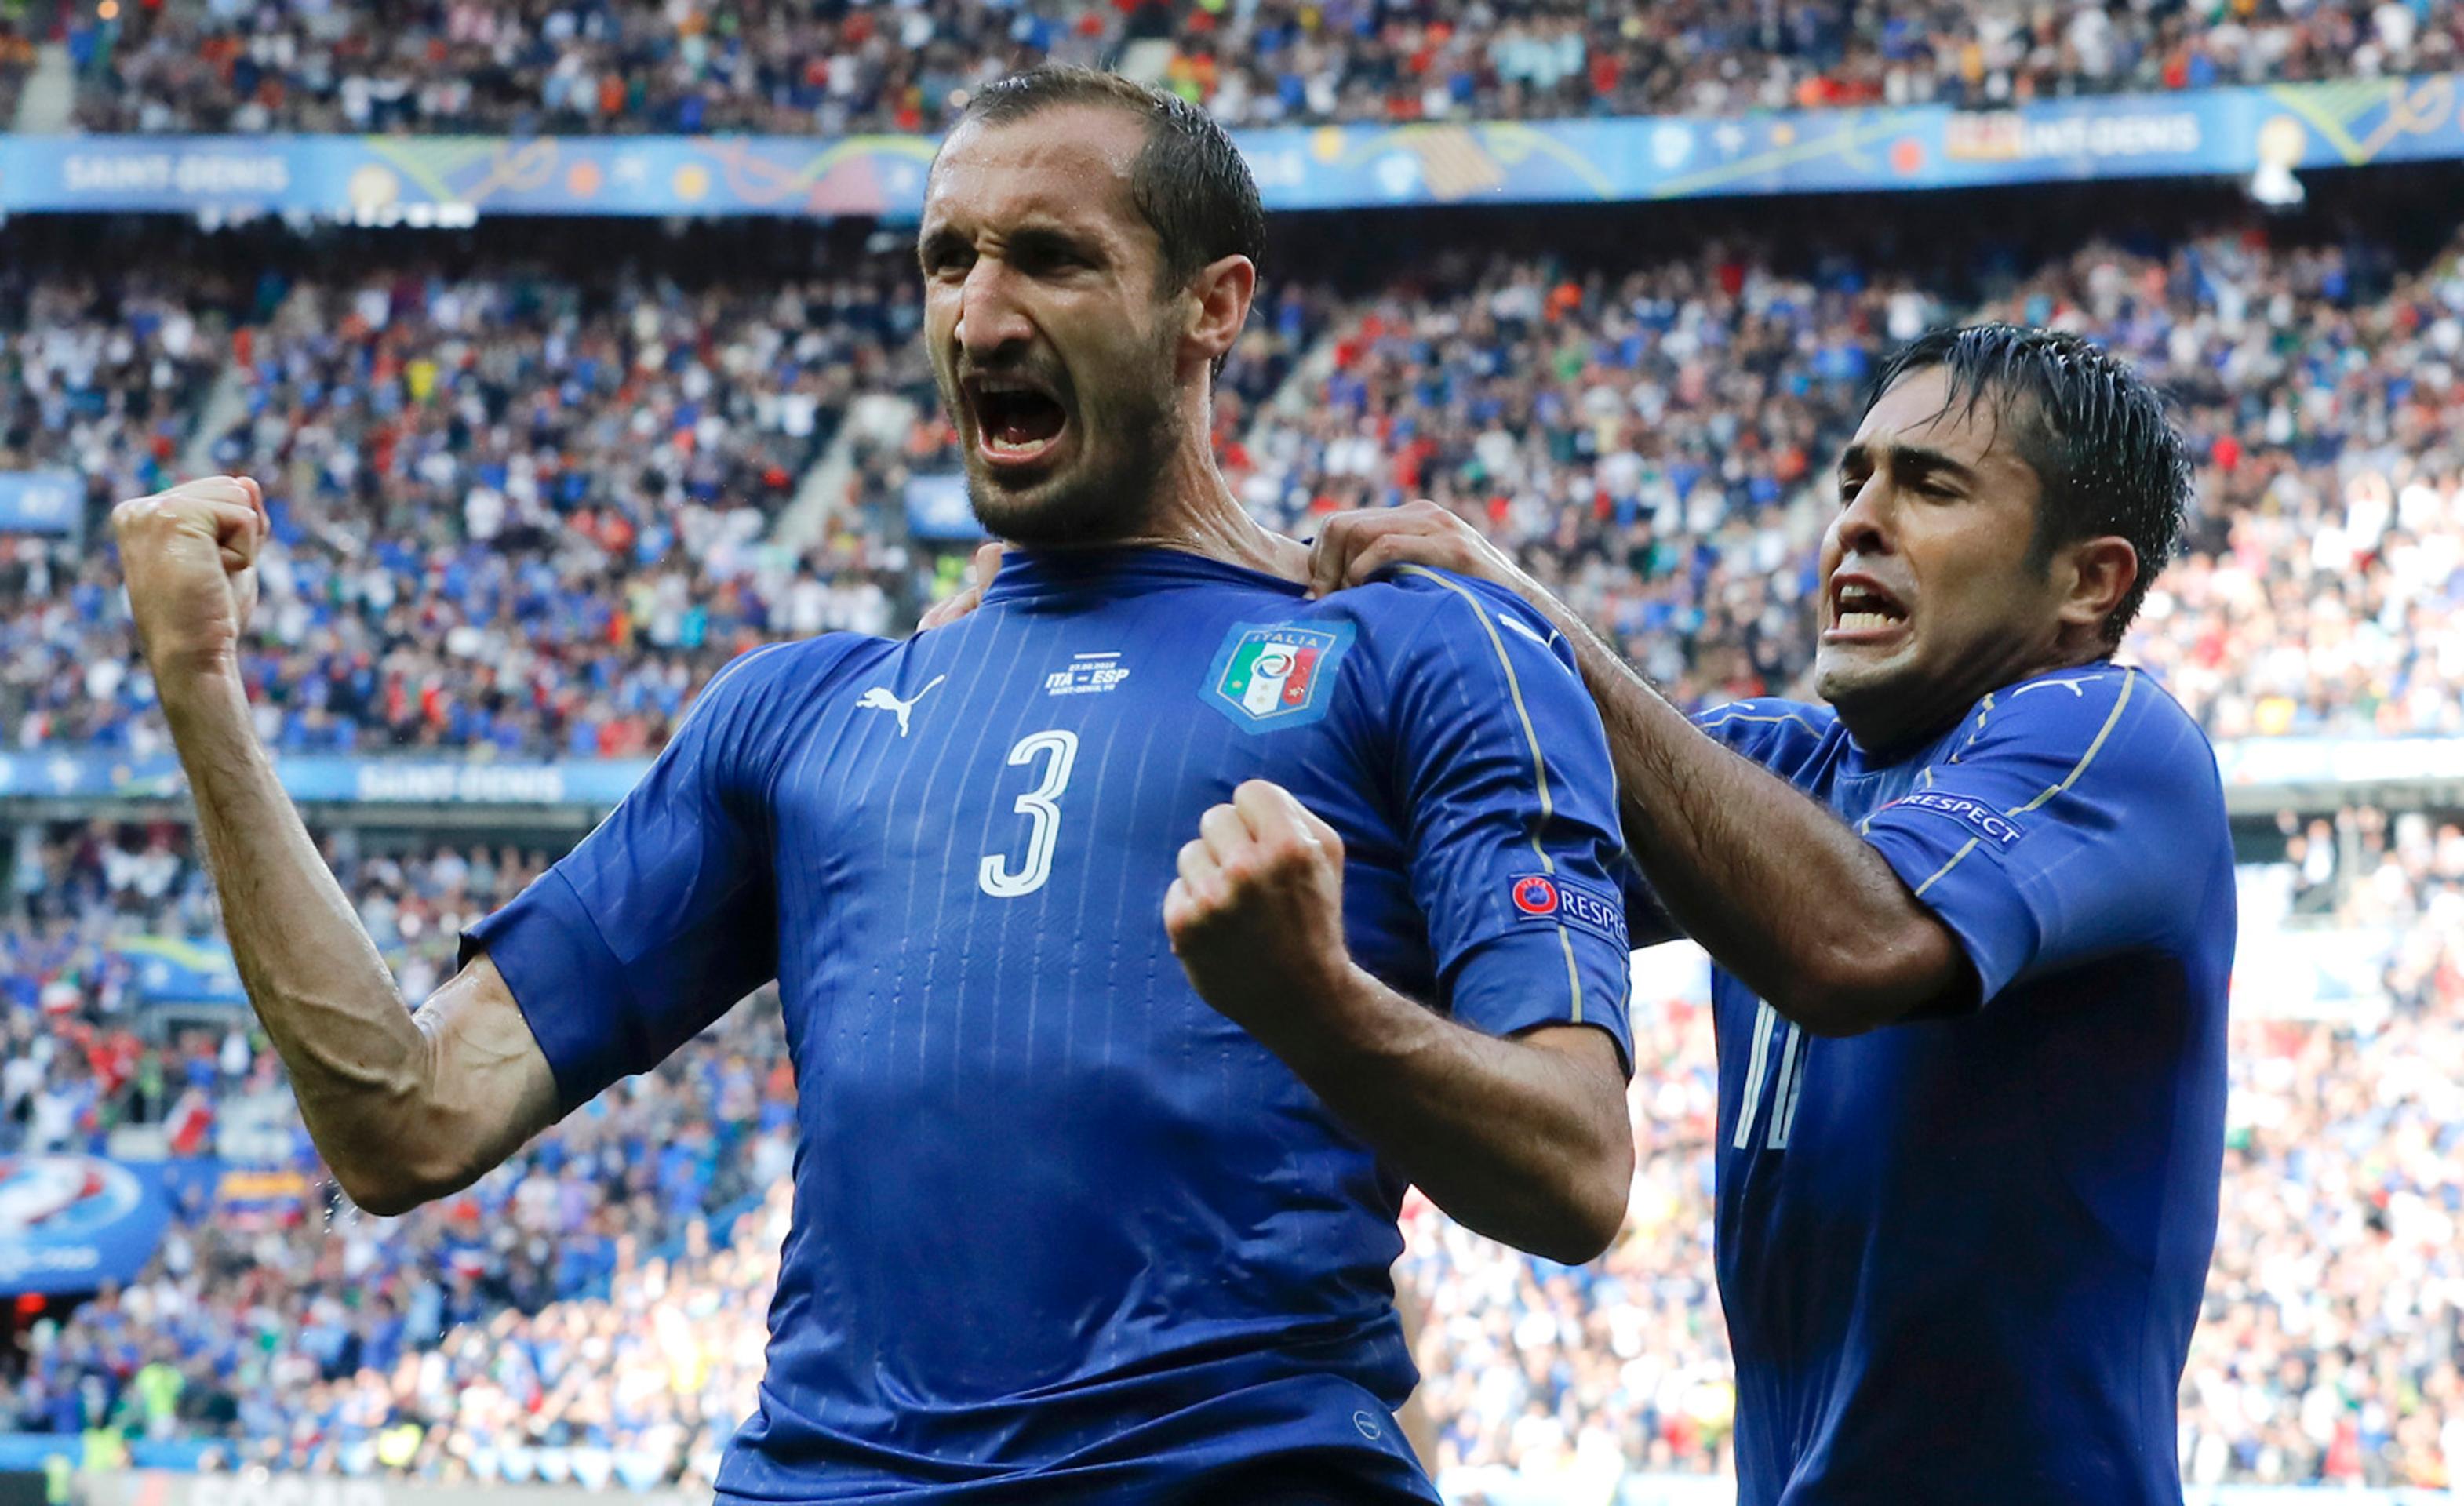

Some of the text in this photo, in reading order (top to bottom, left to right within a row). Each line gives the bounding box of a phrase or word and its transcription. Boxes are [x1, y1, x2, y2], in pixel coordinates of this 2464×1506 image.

[1253, 631, 1318, 646] ITALIA
[1045, 671, 1073, 689] ITA
[1090, 668, 1130, 684] ESP
[979, 729, 1079, 897] 3
[1902, 794, 2020, 844] RESPECT
